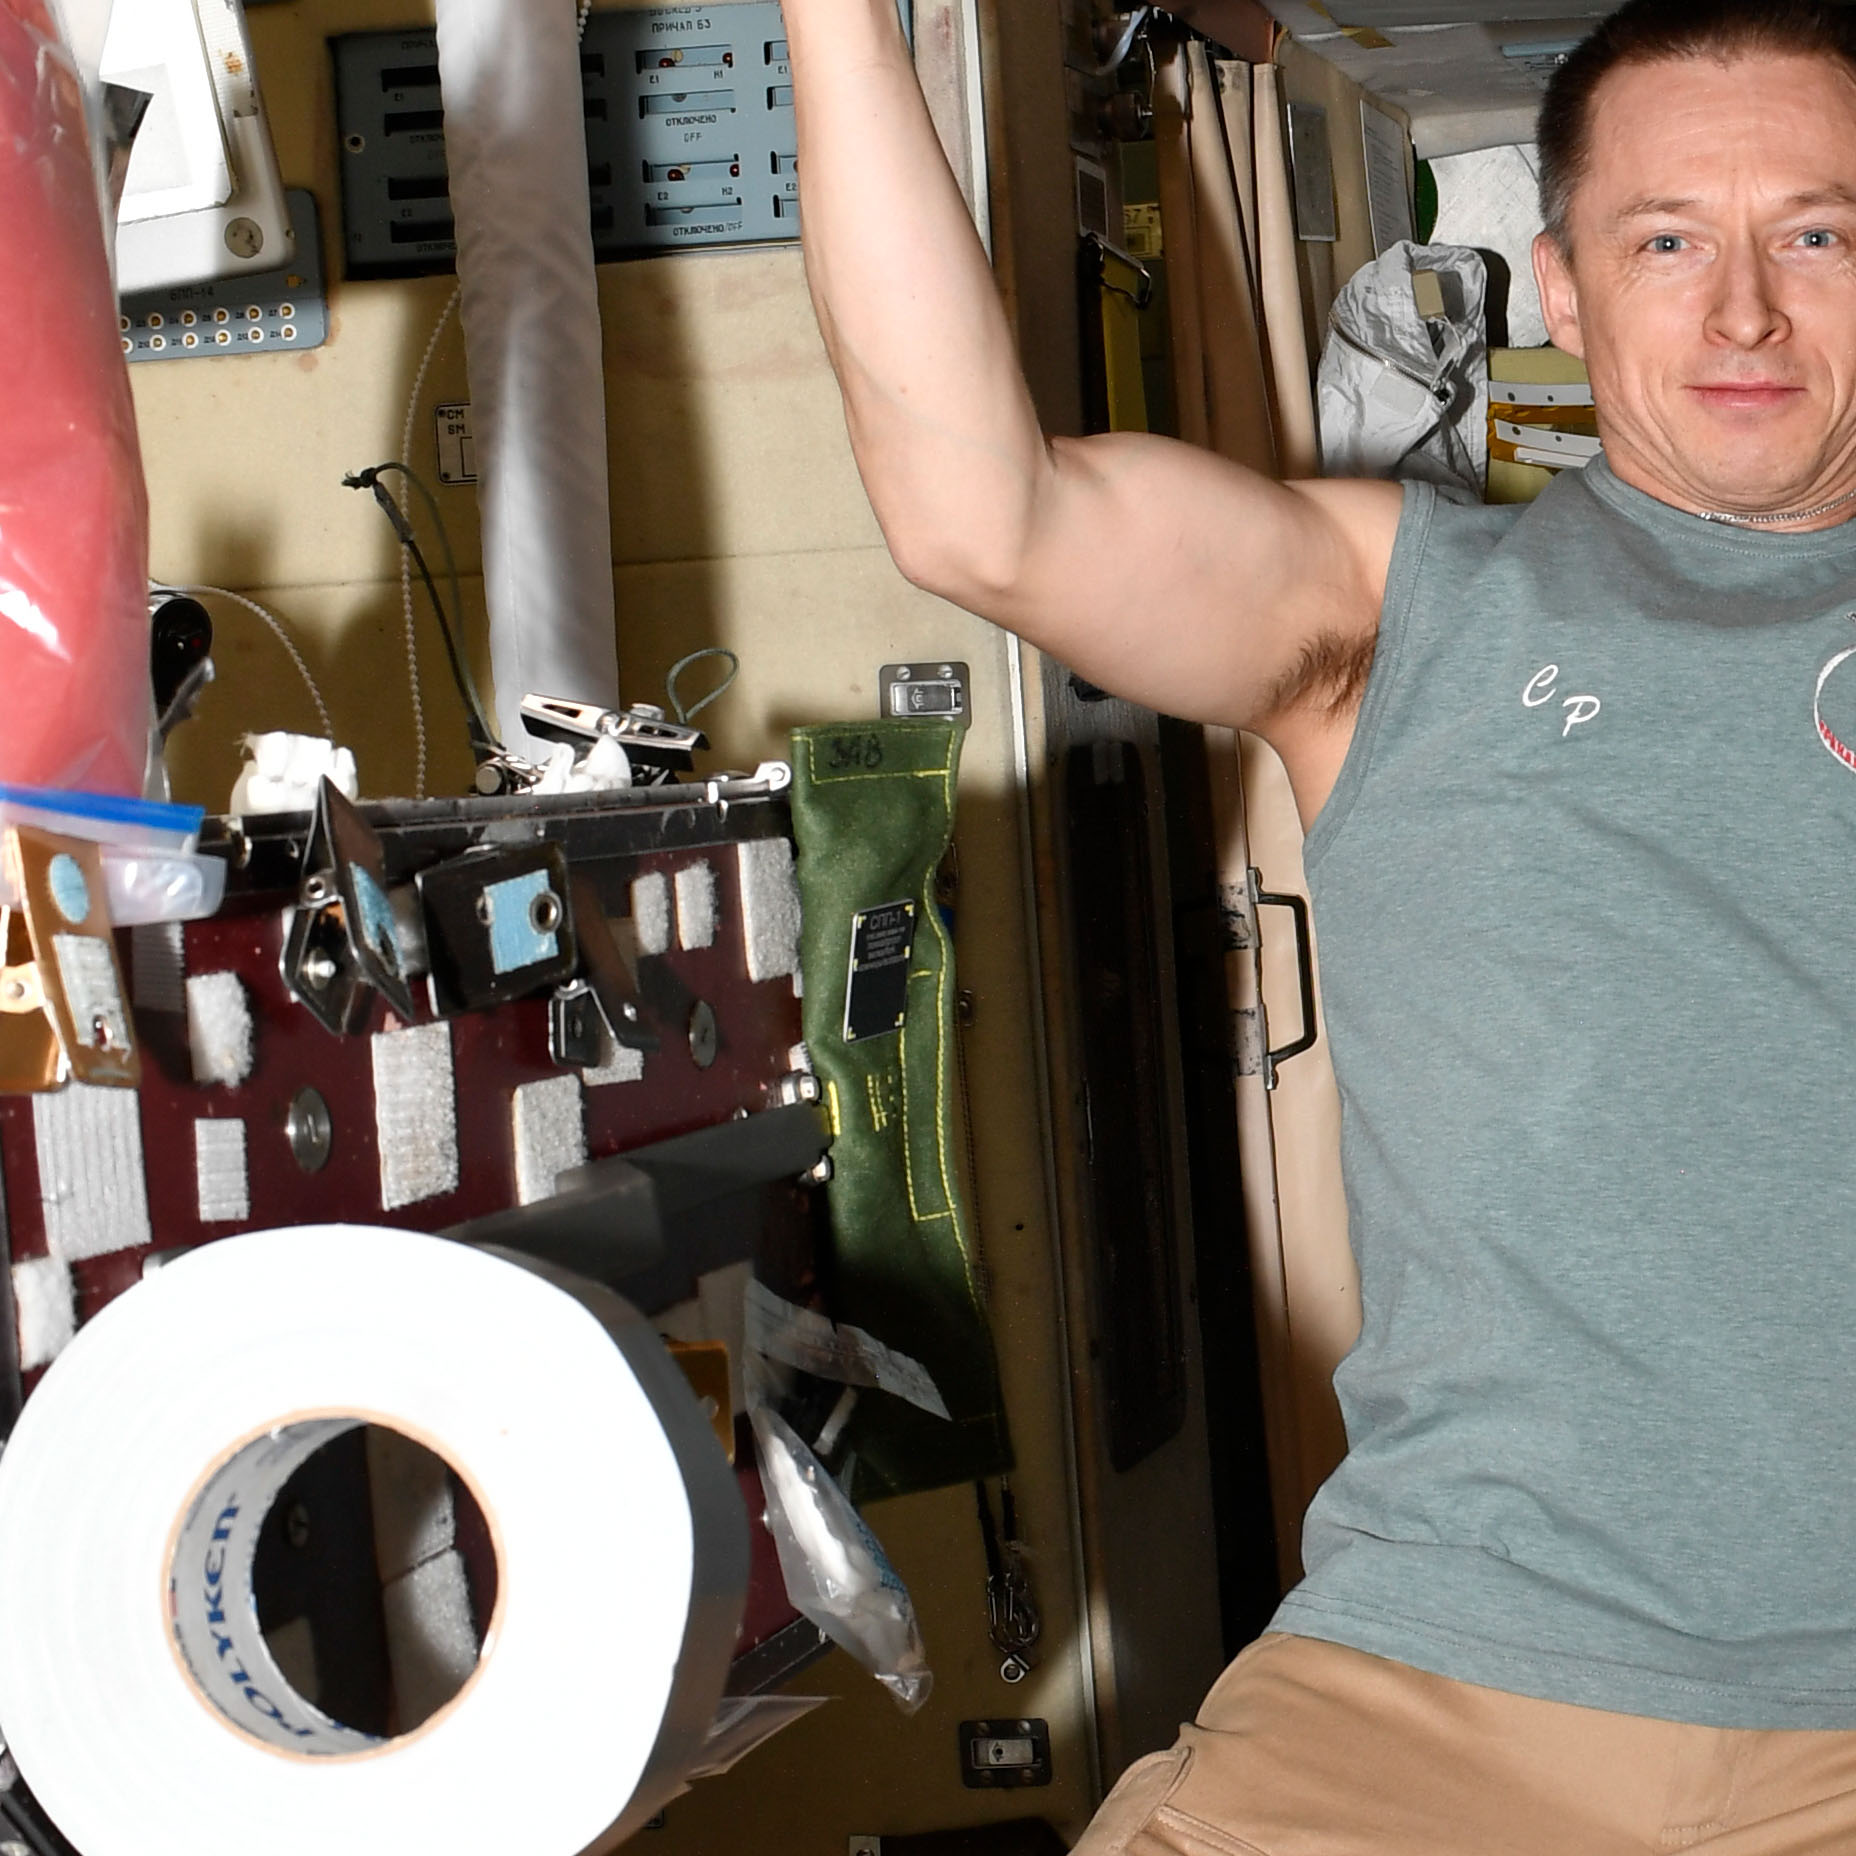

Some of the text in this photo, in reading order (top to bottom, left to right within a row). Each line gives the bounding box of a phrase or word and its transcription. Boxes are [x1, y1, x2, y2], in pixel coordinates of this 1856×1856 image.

[651, 20, 694, 34] ПРИЧАЛ
[665, 115, 718, 128] ОТКЛЮЧЕНО
[683, 132, 703, 143] OFF
[203, 1504, 314, 1738] POLYKEN
